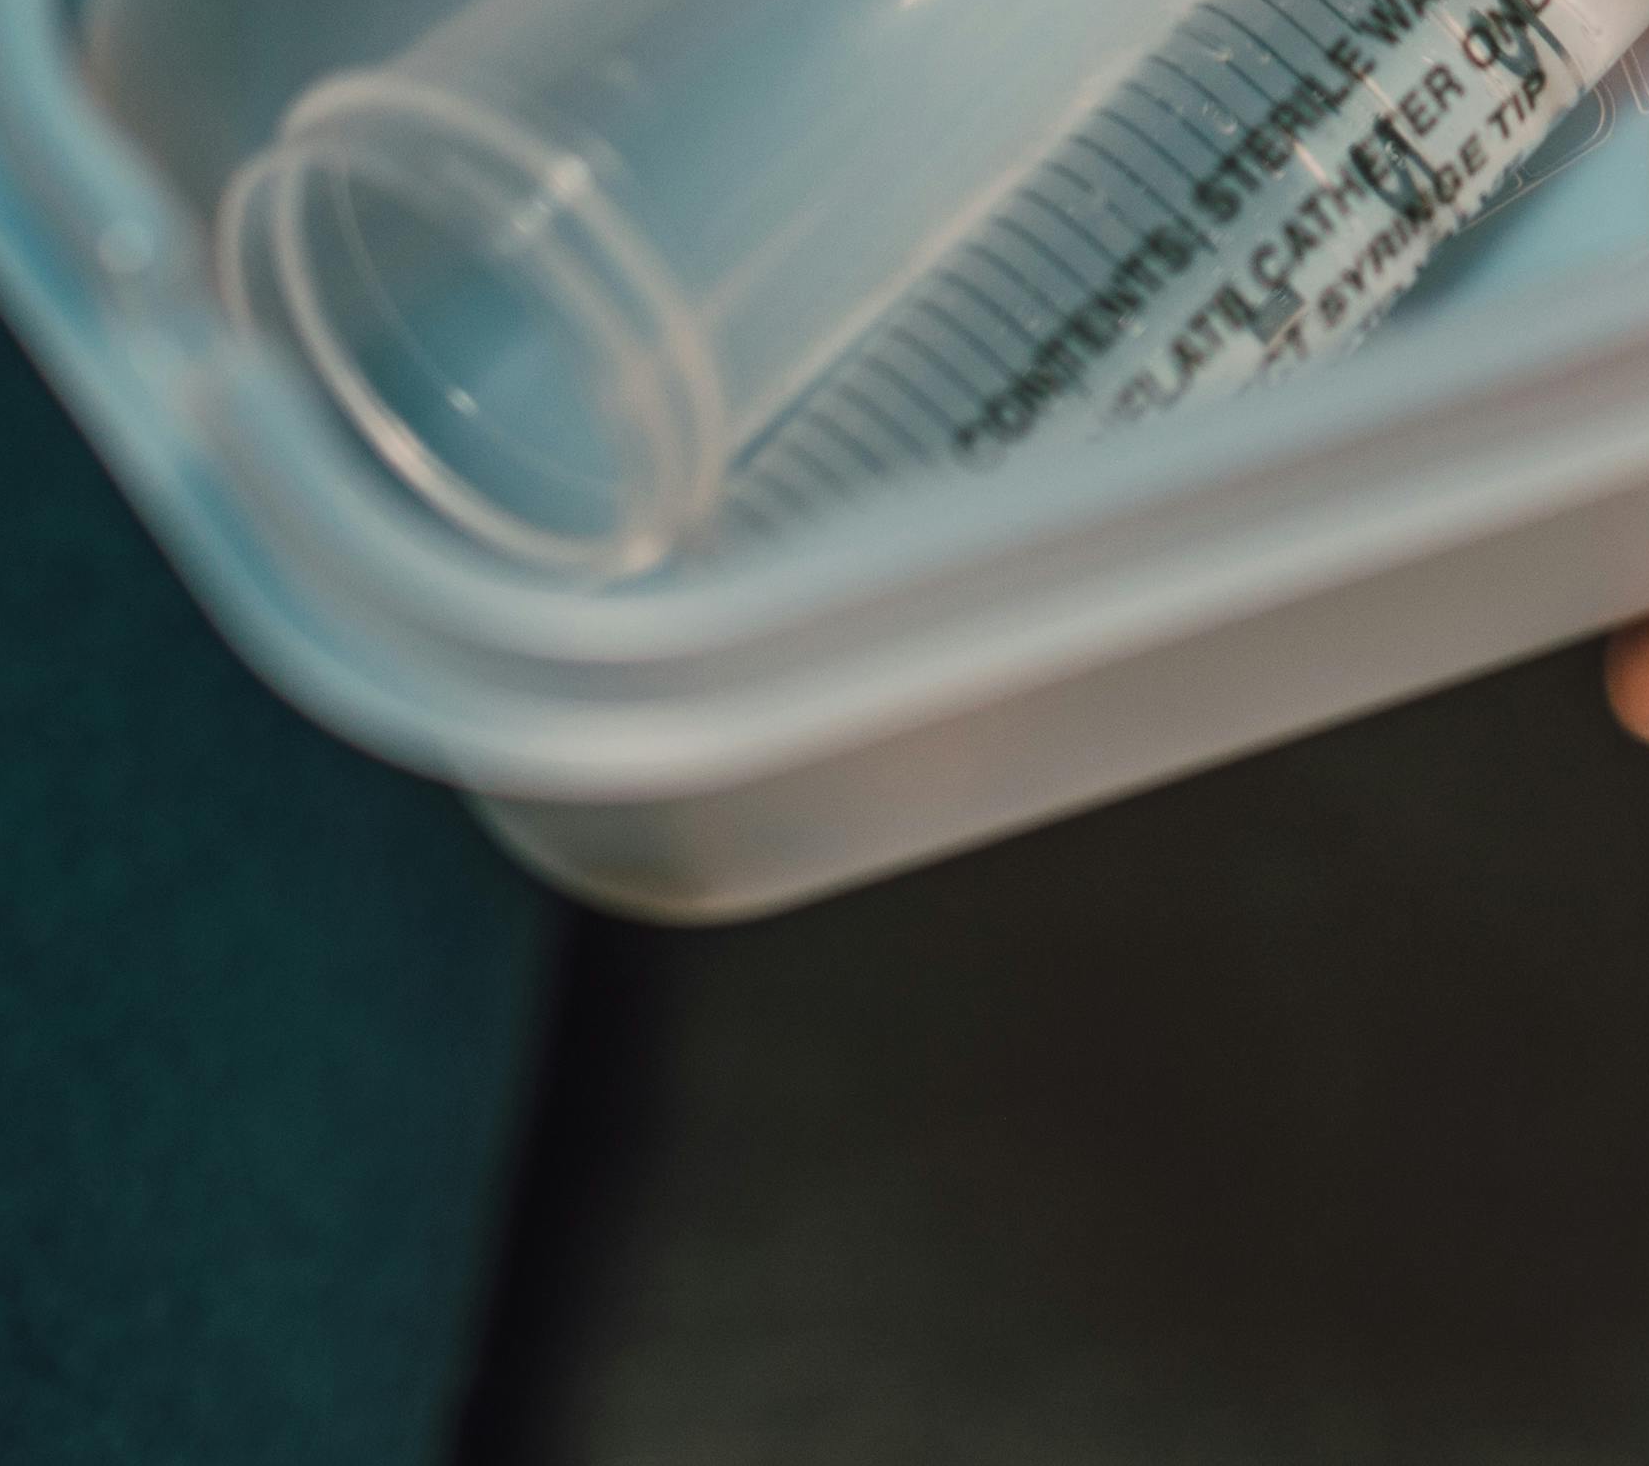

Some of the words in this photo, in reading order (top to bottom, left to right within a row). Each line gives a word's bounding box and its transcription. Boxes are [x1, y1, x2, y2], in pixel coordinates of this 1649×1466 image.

[1190, 41, 1379, 226] STERILE
[1248, 64, 1468, 293] CATHETER
[1318, 131, 1494, 328] SYRINGE
[1491, 66, 1553, 142] TIP
